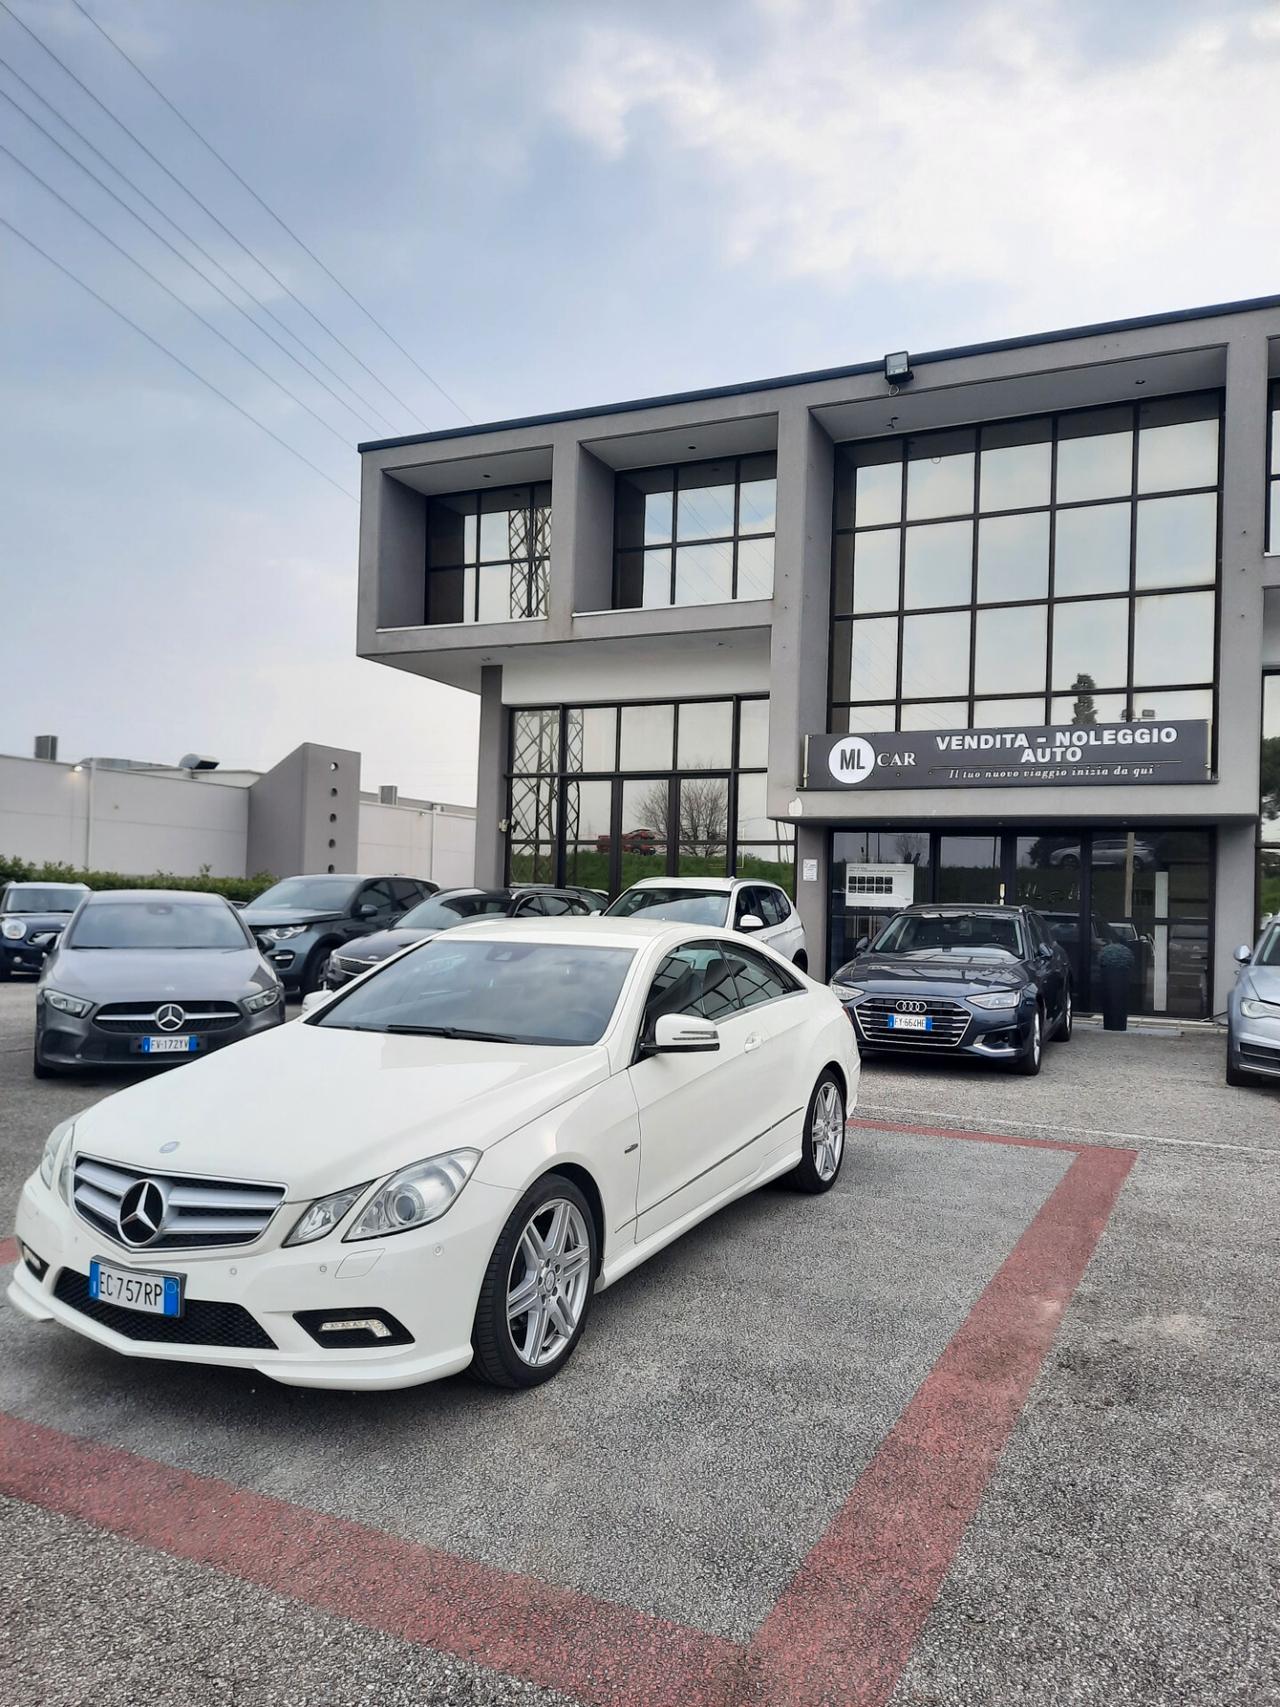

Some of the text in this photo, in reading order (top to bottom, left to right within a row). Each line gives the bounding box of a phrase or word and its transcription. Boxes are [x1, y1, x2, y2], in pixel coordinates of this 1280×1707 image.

[936, 733, 1030, 750] VENDITA
[1050, 727, 1179, 746] NOLEGGIO
[839, 748, 917, 770] ML CAR
[1021, 747, 1083, 763] AUTO
[949, 764, 1154, 779] Il tuo nuovo viaggio inizia da qui
